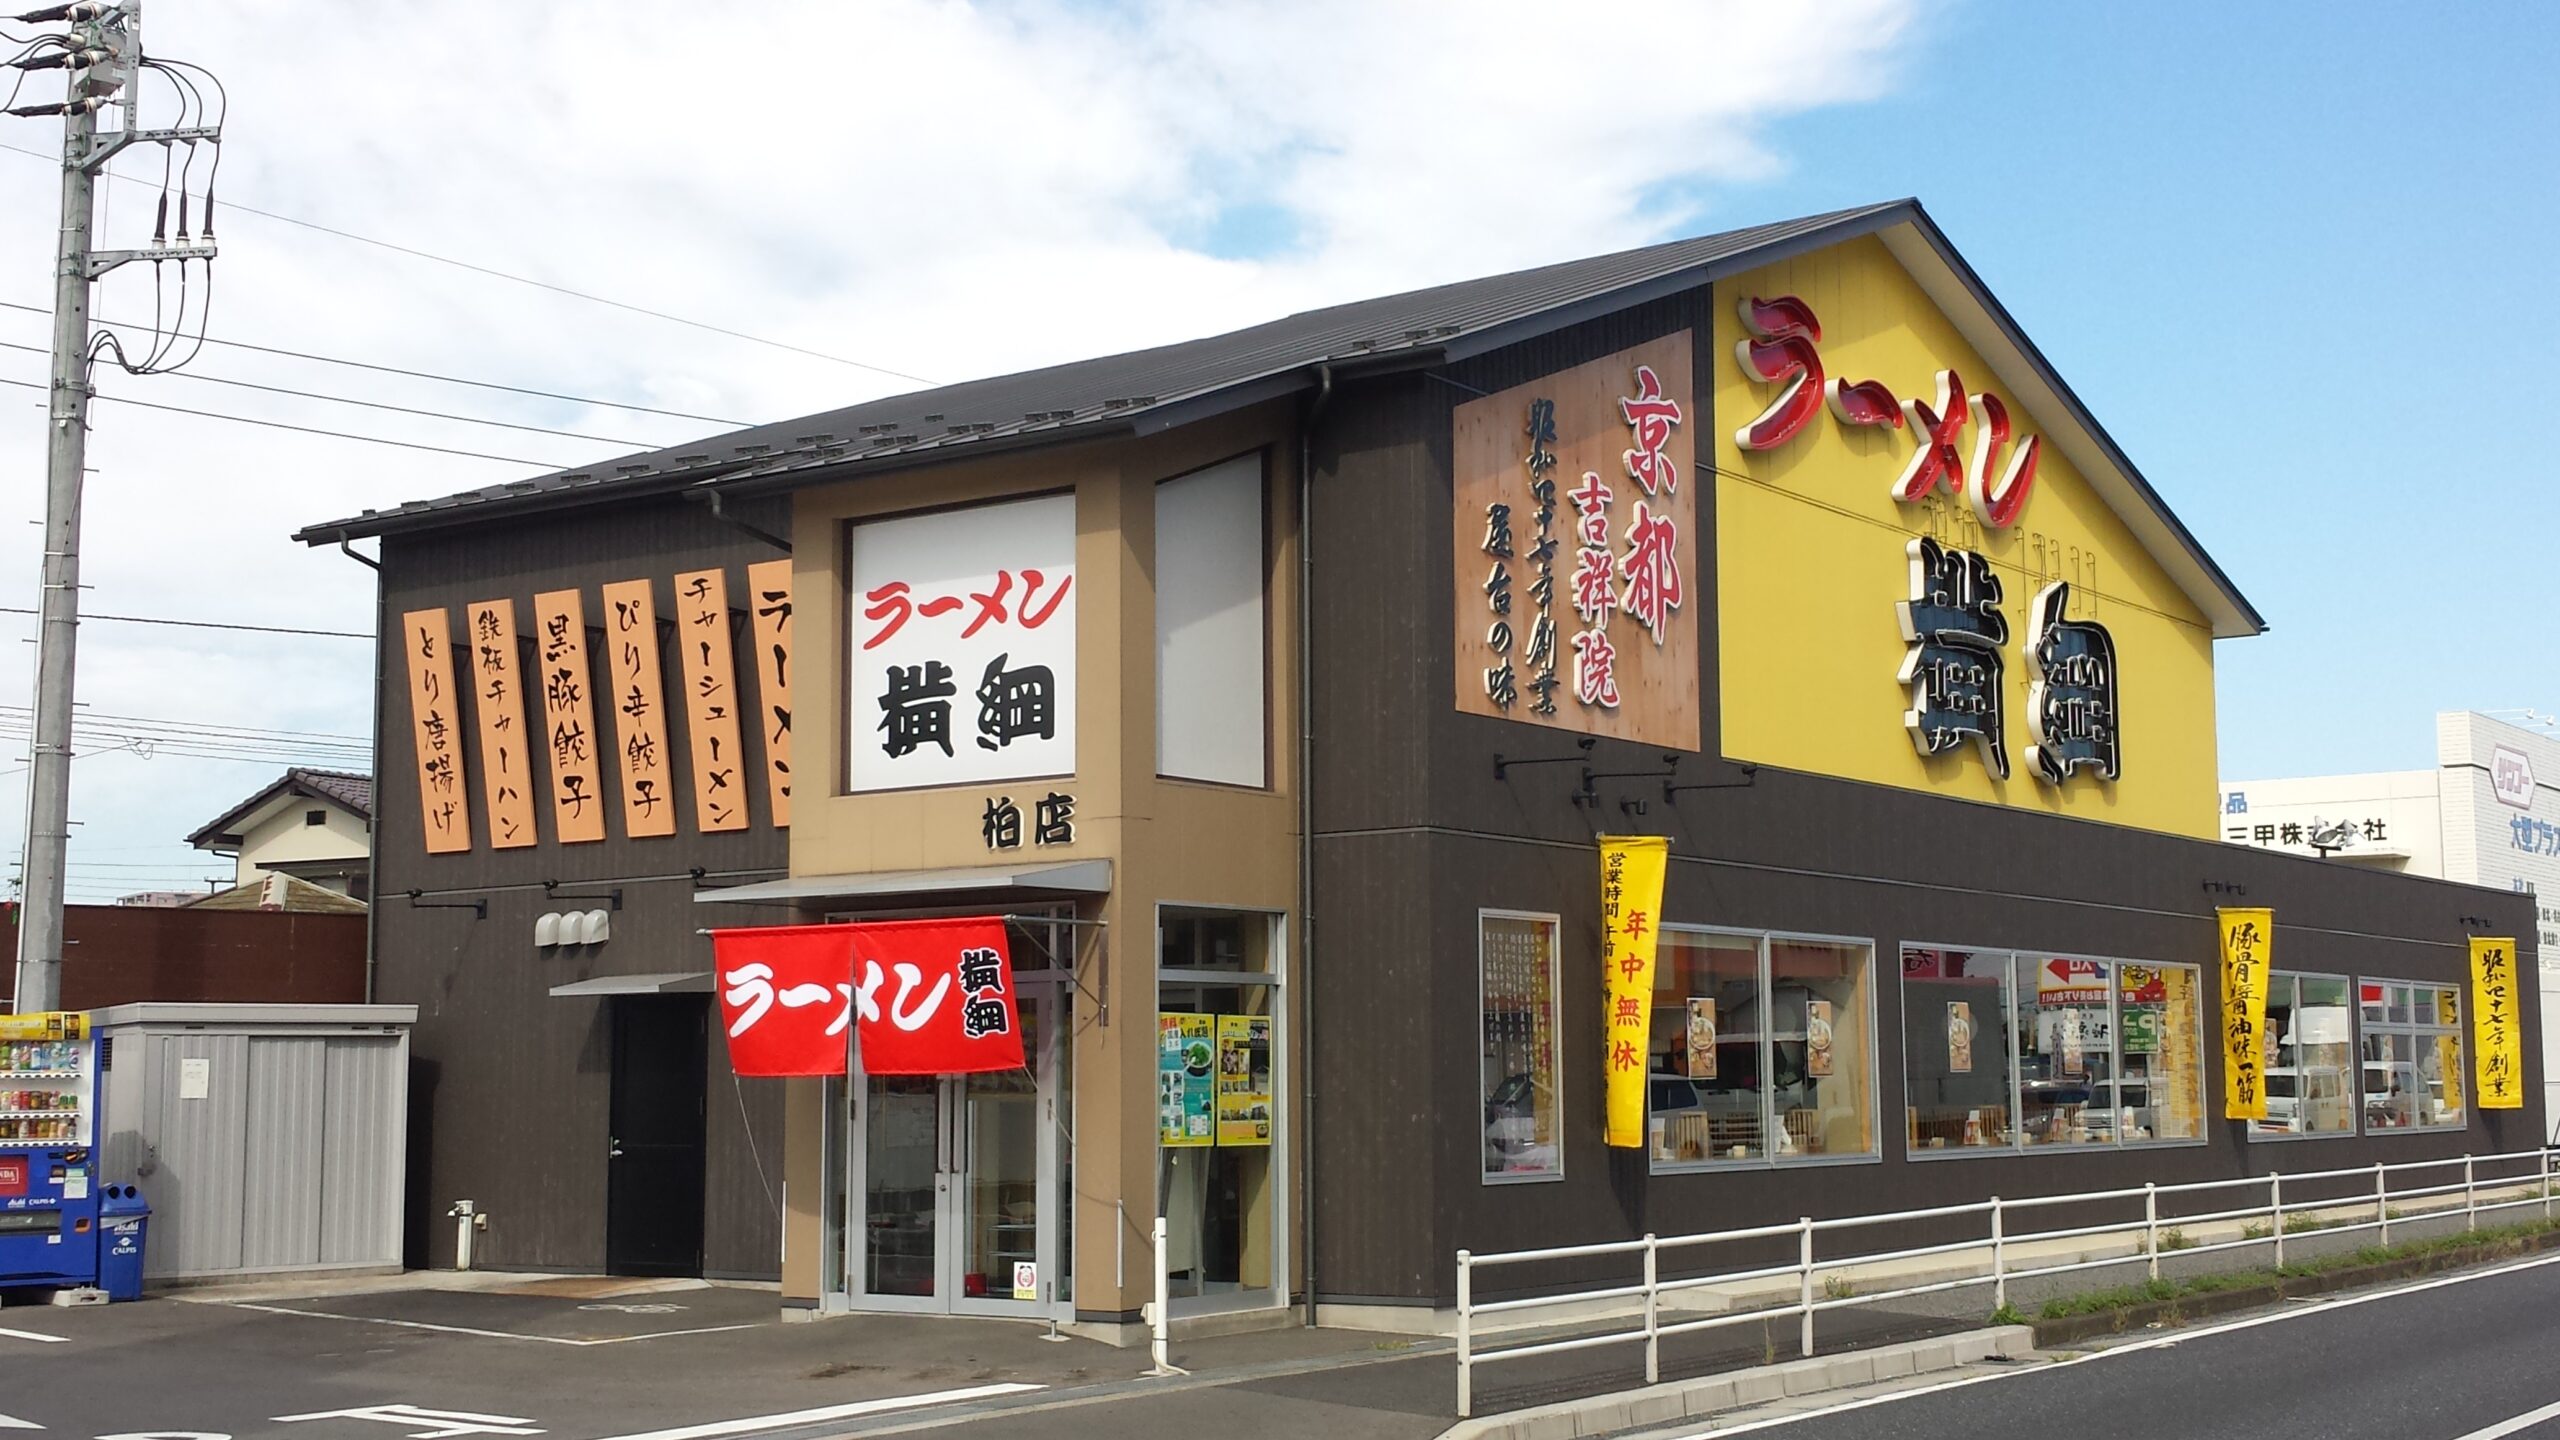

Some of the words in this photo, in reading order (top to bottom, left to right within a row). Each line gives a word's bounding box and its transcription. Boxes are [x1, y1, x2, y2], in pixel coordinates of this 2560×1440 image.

[1619, 364, 1683, 647] 京都
[1735, 295, 2041, 529] ラーメン
[863, 569, 1072, 650] ラーメン
[1481, 502, 1517, 712] 屋台の味
[1568, 471, 1620, 709] 吉祥院
[1895, 536, 2120, 787] 横綱
[420, 626, 456, 835] とり唐揚げ
[478, 609, 520, 840] 鉄板チャーハン
[546, 614, 592, 820] 黒豚餃子
[615, 600, 662, 820] ぴり辛餃子
[684, 578, 734, 824] チャーシューメン
[876, 652, 1055, 759] 横綱
[982, 792, 1078, 850] 柏店
[1604, 852, 1626, 918] 営業時間
[2227, 818, 2387, 846] 三甲株社
[725, 960, 951, 1038] ラーメン
[958, 947, 1009, 1038] 横綱
[1611, 909, 1649, 1072] 年中無休
[2225, 922, 2261, 1104] 豚骨醤油味一筋
[2481, 949, 2510, 1097] 昭和四十七年創業
